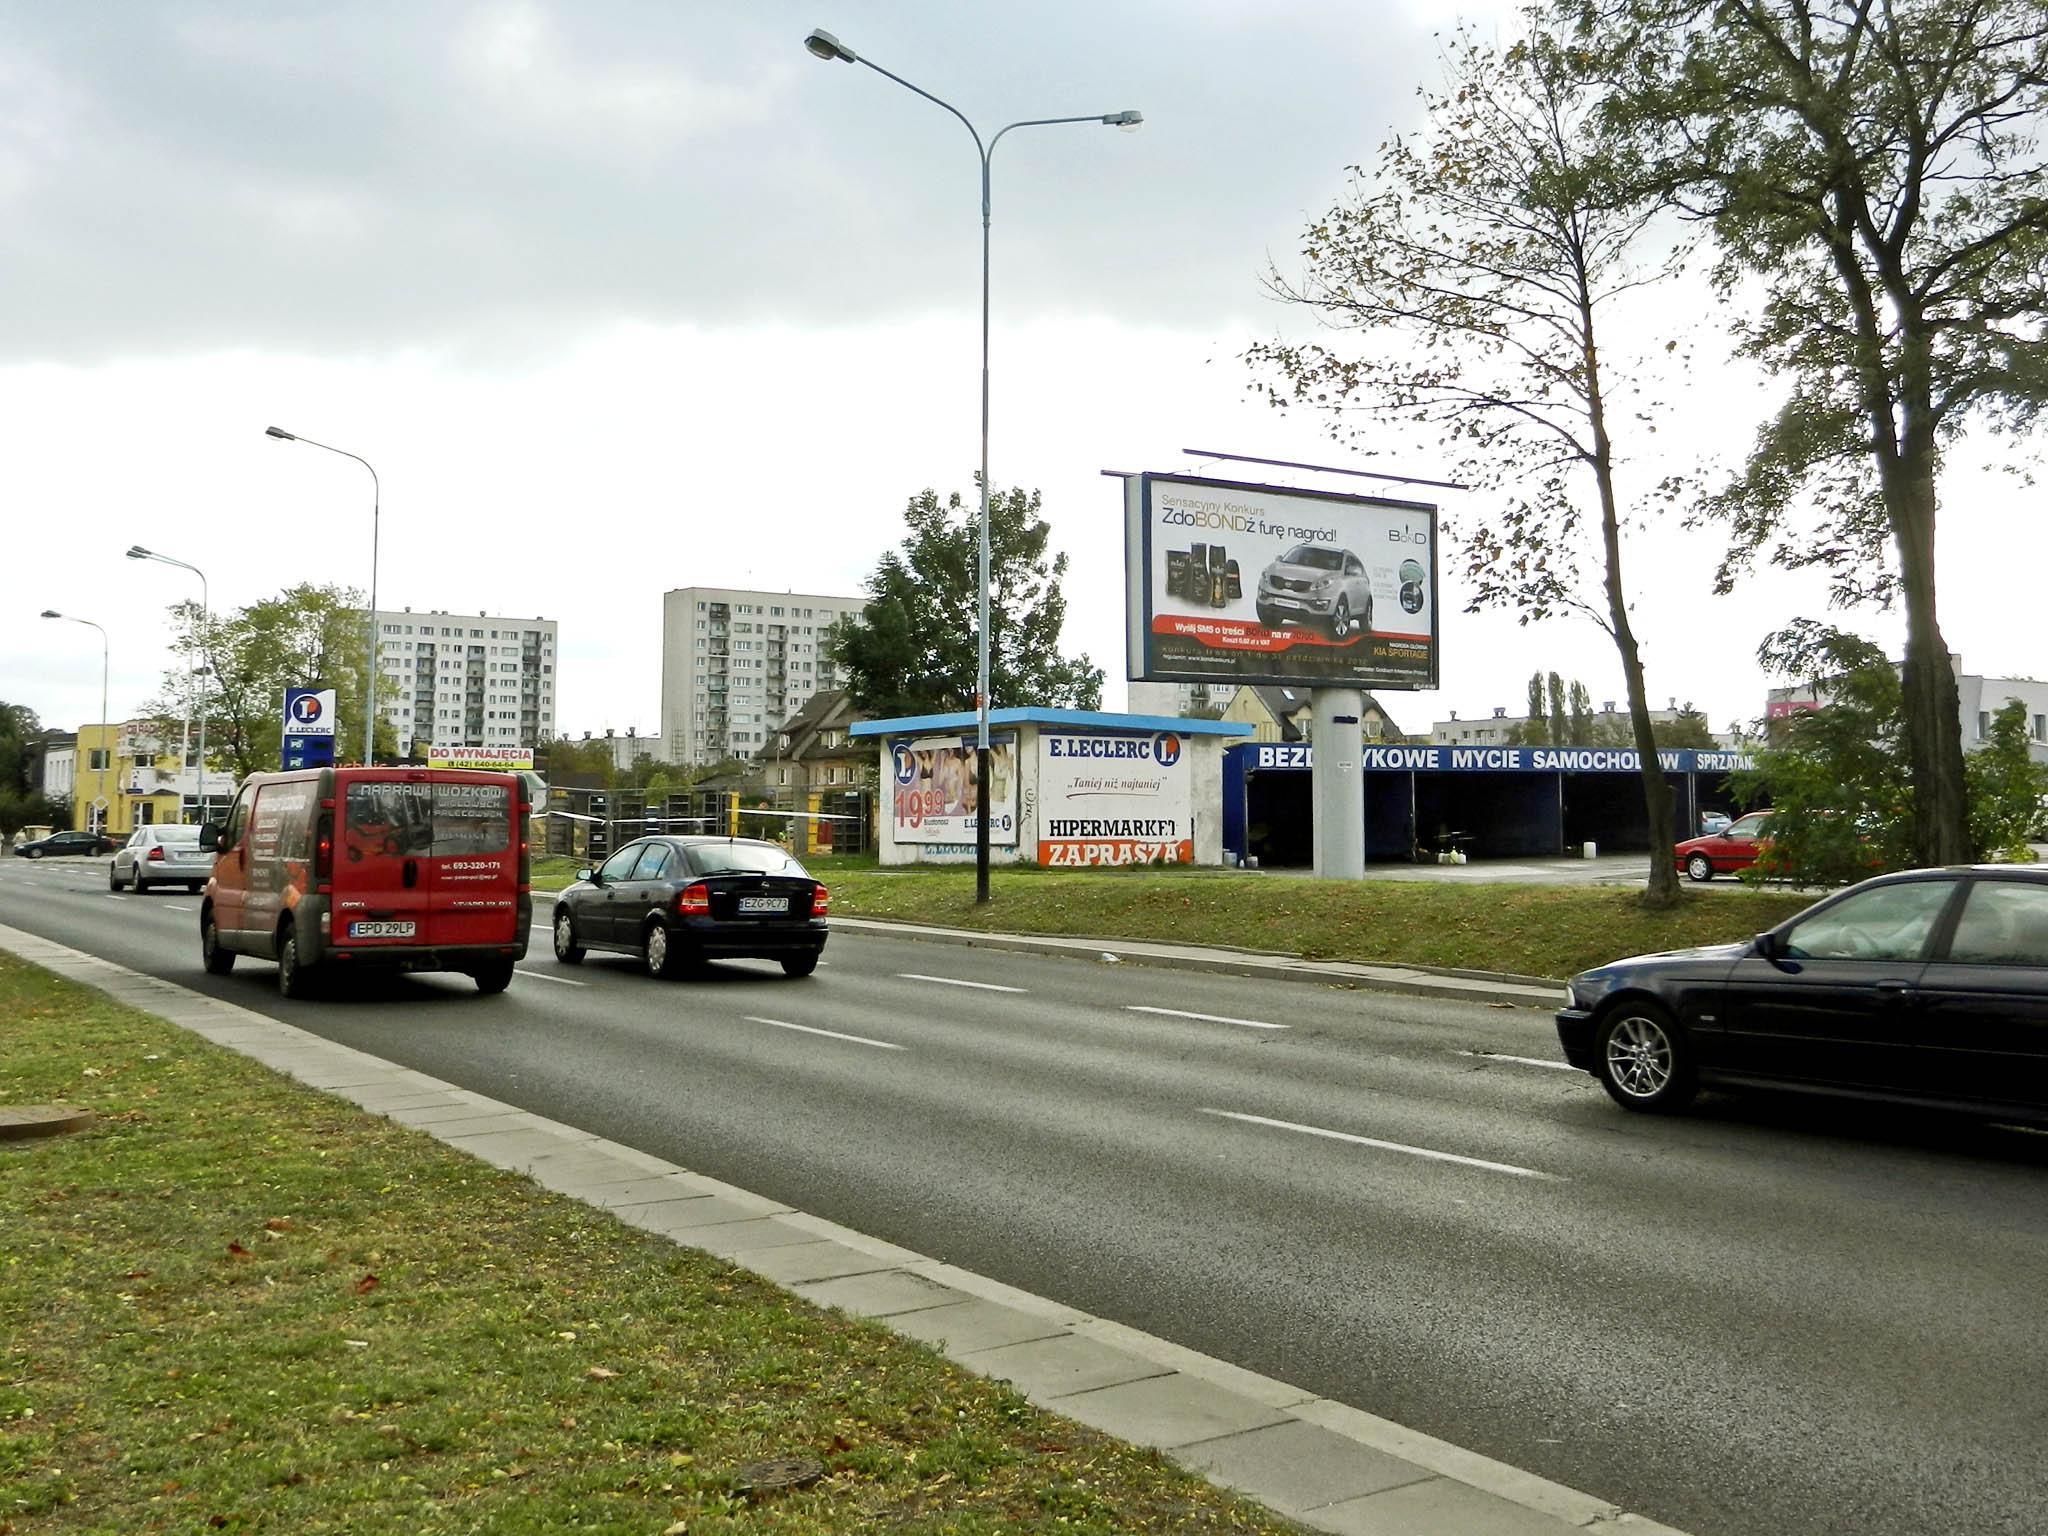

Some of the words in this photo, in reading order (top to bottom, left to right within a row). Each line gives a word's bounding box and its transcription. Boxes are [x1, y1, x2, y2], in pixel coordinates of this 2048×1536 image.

[1161, 494, 1220, 513] Sensacyjny
[1224, 501, 1265, 516] Konkurs
[1162, 506, 1256, 533] ZdoBONDź
[1259, 520, 1285, 540] furę
[1288, 527, 1337, 543] nagród!
[1196, 624, 1214, 634] SMS
[1373, 647, 1387, 656] KIA
[1388, 648, 1428, 659] SPORTAGE
[430, 748, 449, 758] DO
[453, 748, 532, 761] WYNAJĘCIA
[1050, 738, 1150, 759] E.LECLERC
[1452, 749, 1520, 769] MYCIE
[1104, 777, 1119, 790] niż
[1049, 819, 1175, 837] HIPERMARKET
[453, 861, 500, 870] 693-320-171
[744, 898, 765, 908] EZG
[357, 923, 382, 935] EPD
[385, 922, 414, 935] 29LP
